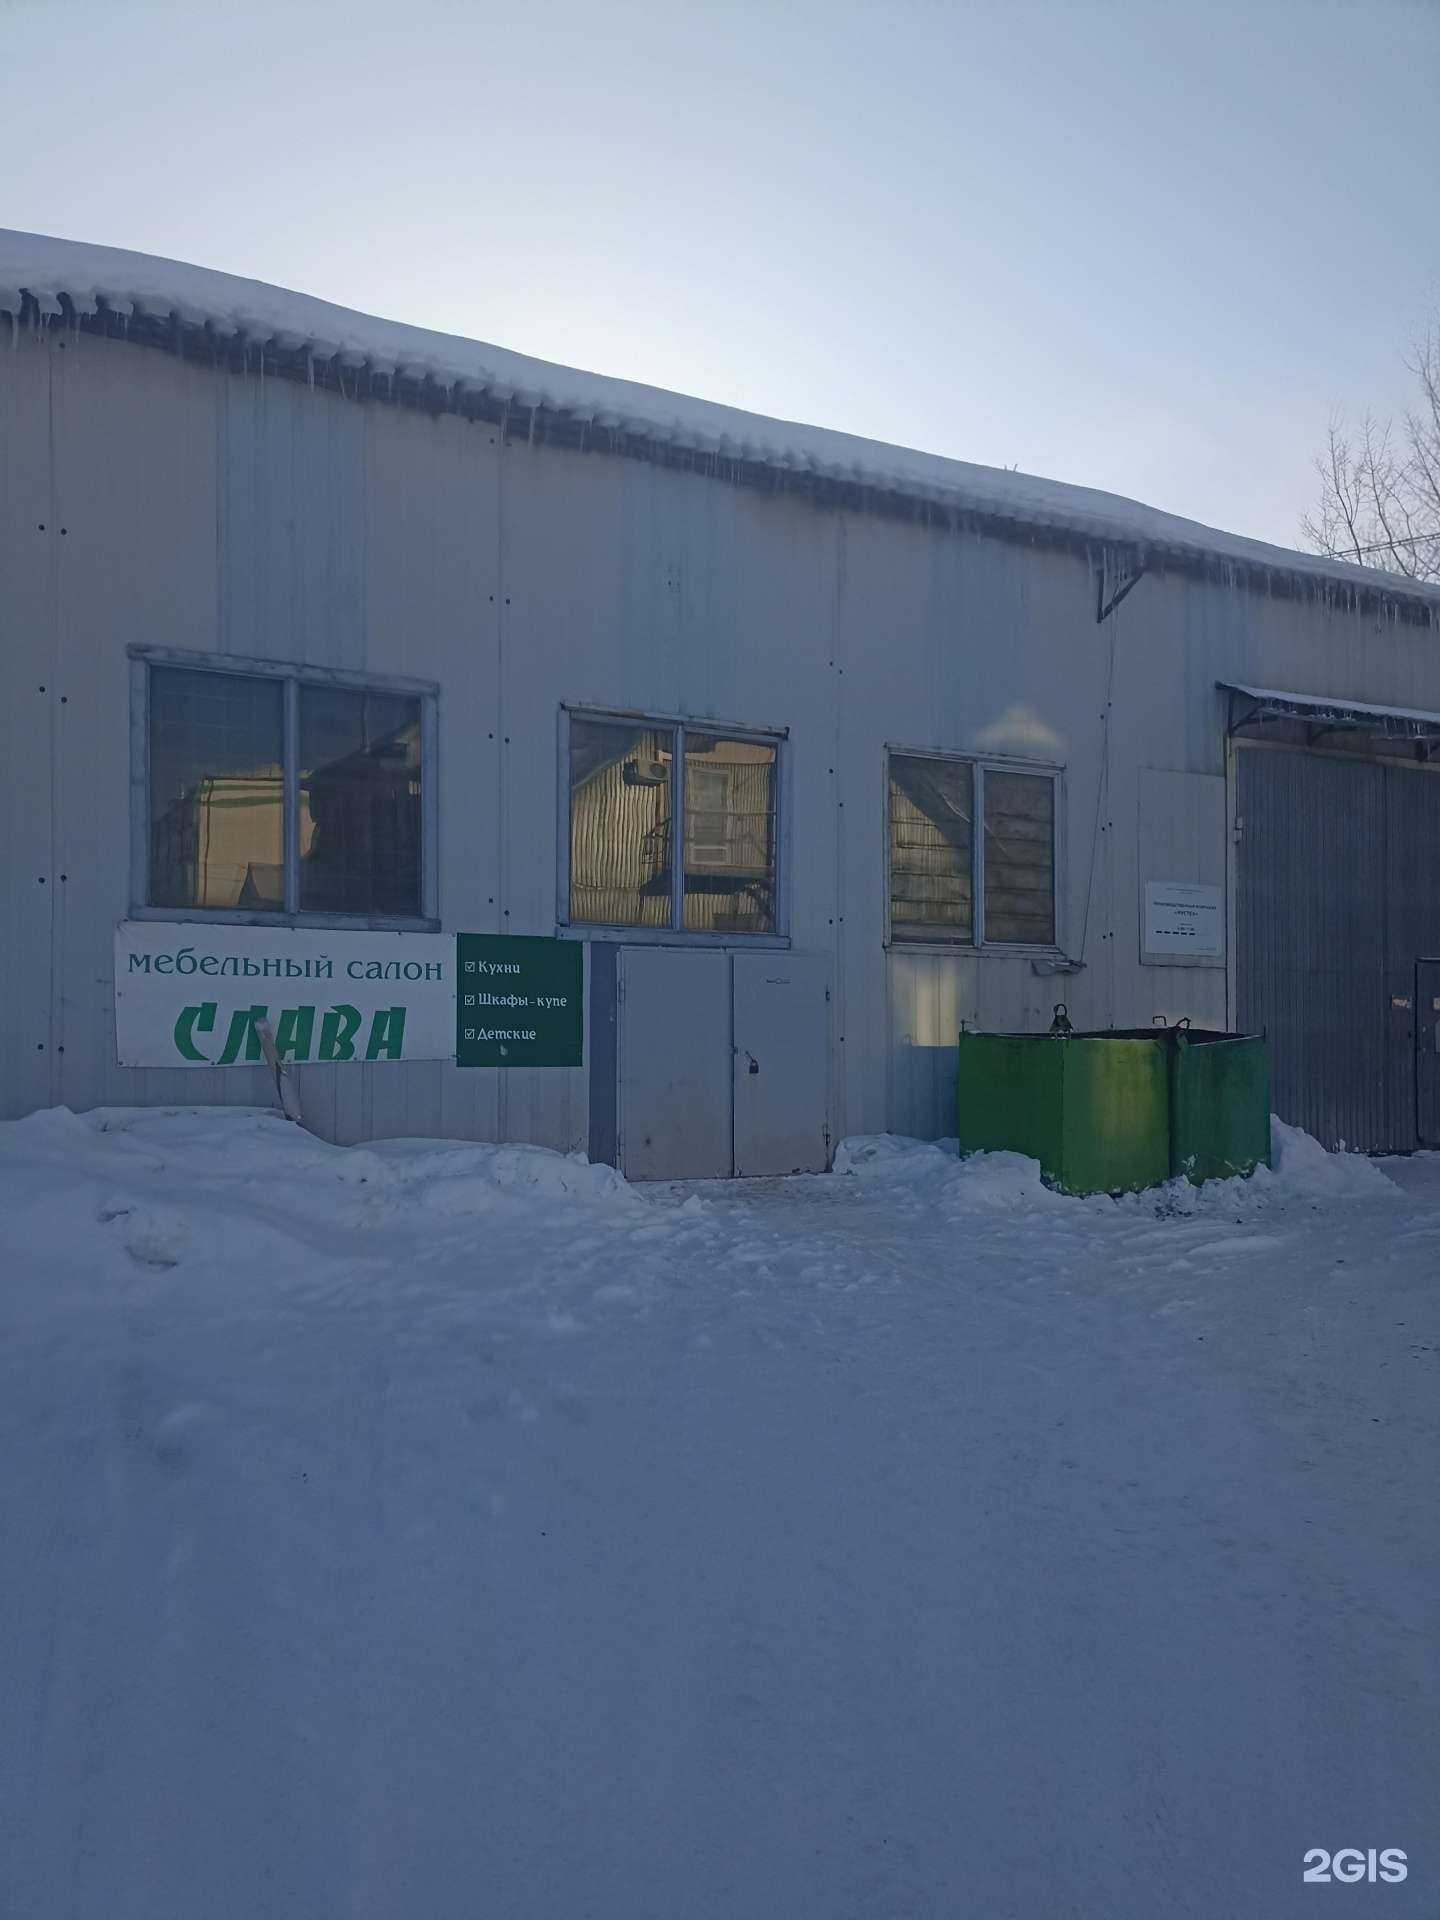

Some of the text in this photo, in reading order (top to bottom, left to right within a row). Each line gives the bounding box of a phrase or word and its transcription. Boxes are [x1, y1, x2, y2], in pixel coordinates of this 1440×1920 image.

[128, 947, 443, 981] мебельный салон
[478, 960, 521, 975] Кухни
[173, 1002, 408, 1065] СЛАВА
[477, 1027, 537, 1041] Детские
